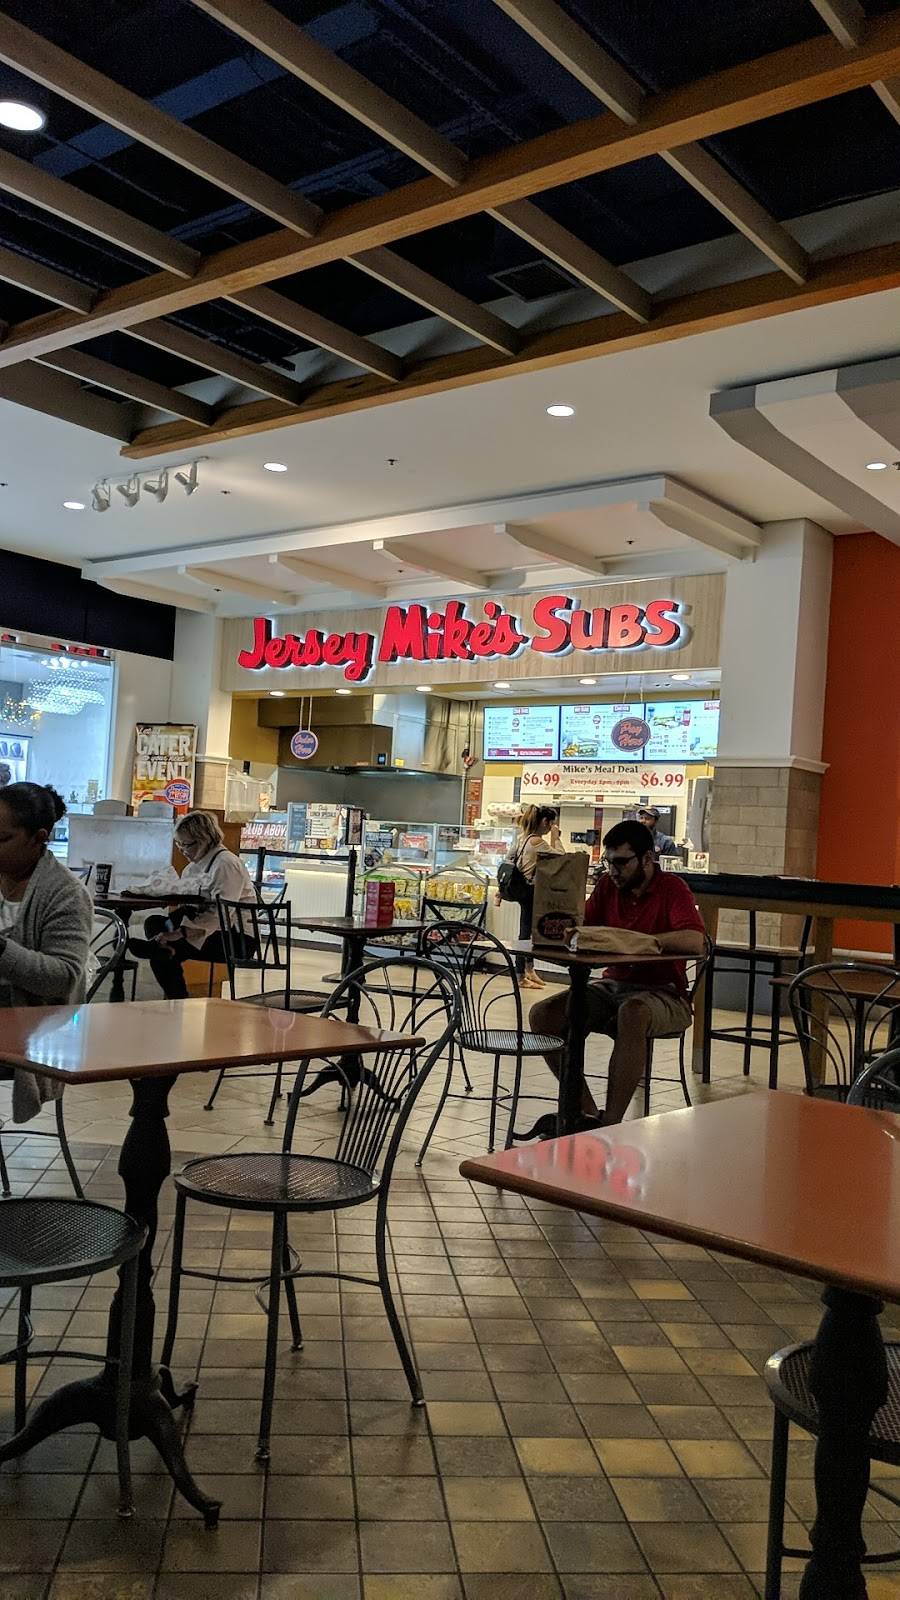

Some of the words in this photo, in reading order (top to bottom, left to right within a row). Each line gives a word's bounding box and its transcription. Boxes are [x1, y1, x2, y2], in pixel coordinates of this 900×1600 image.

[238, 617, 375, 681] Jersey
[379, 600, 529, 661] Mike's
[531, 595, 680, 653] SUBS
[137, 735, 191, 756] CATER
[135, 761, 189, 781] EVENT
[563, 765, 593, 774] Mike's
[594, 765, 615, 773] Meal
[618, 765, 638, 773] Deal
[523, 772, 560, 787] $6.99
[570, 778, 597, 786] Everyday
[640, 772, 684, 788] $6.99
